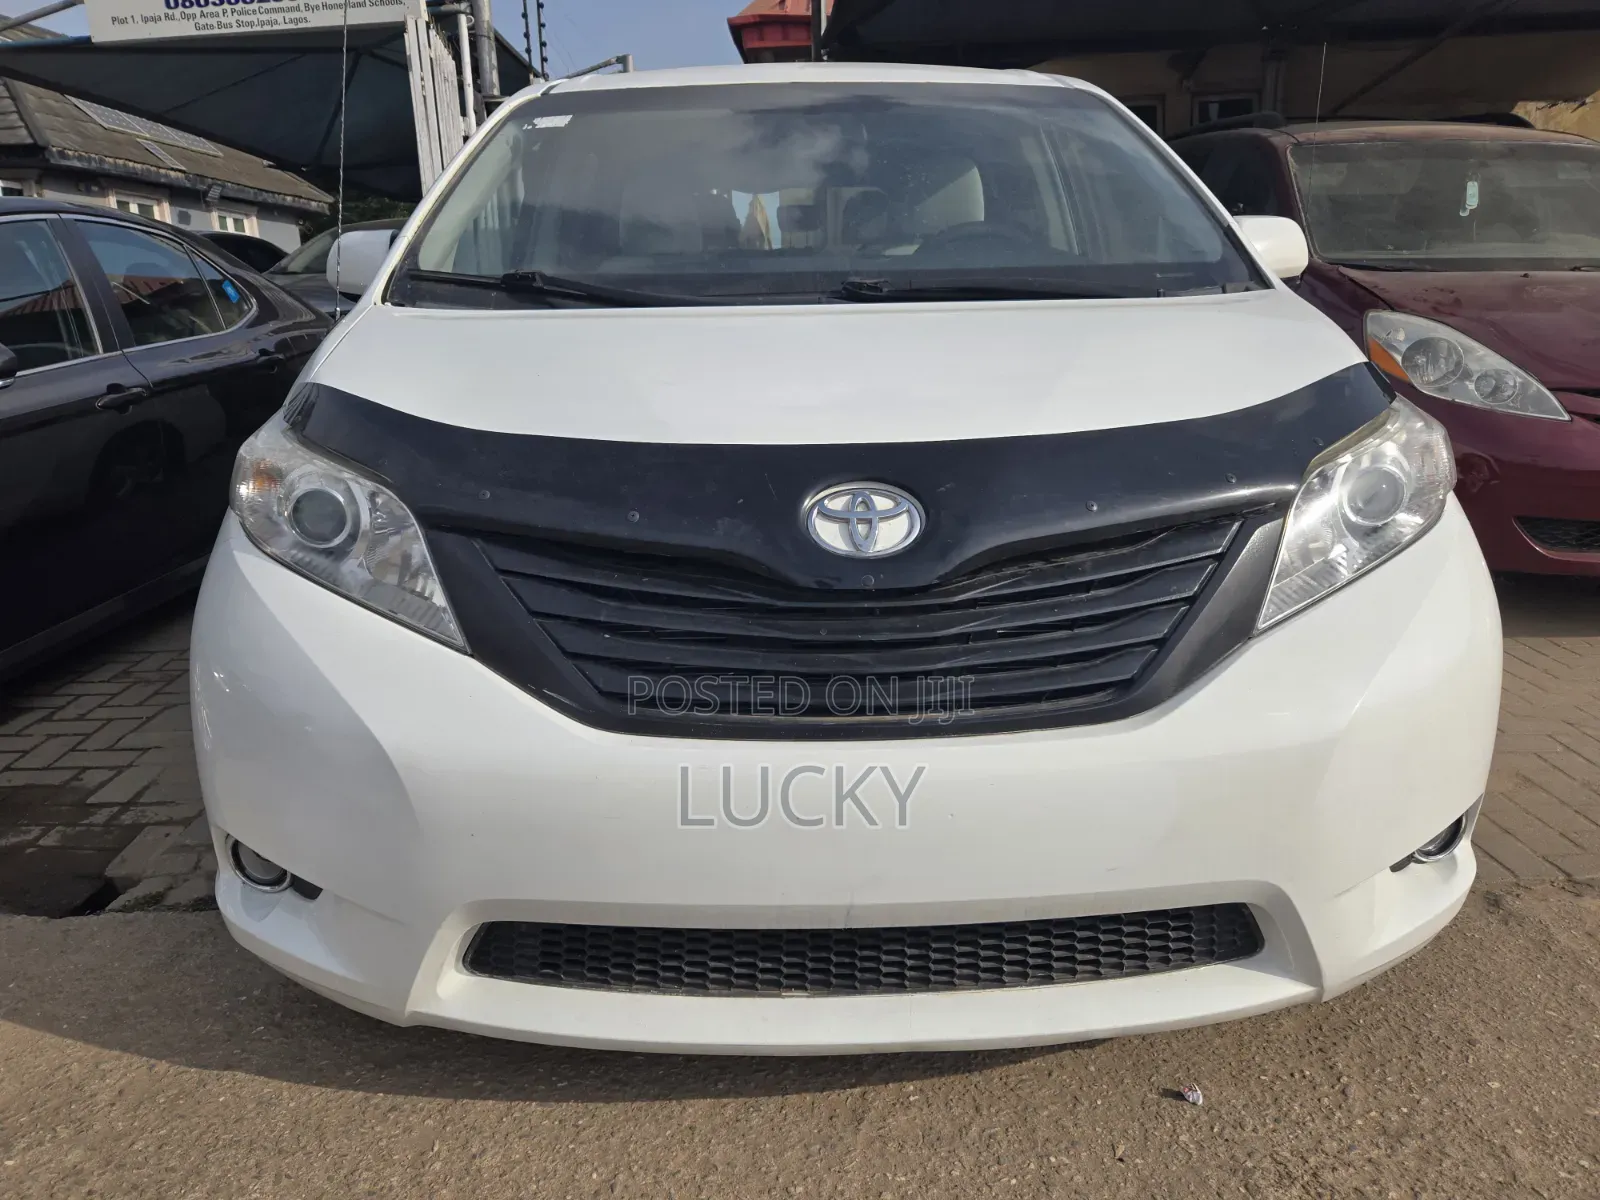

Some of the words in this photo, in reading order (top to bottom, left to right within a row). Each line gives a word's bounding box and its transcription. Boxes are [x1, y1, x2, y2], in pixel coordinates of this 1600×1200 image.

[111, 16, 129, 25] Plot
[140, 13, 162, 24] Ipaja
[200, 9, 220, 19] Area
[230, 6, 256, 17] Police
[304, 2, 320, 13] Bye
[216, 20, 233, 30] Bus
[283, 15, 311, 26] Lagos.
